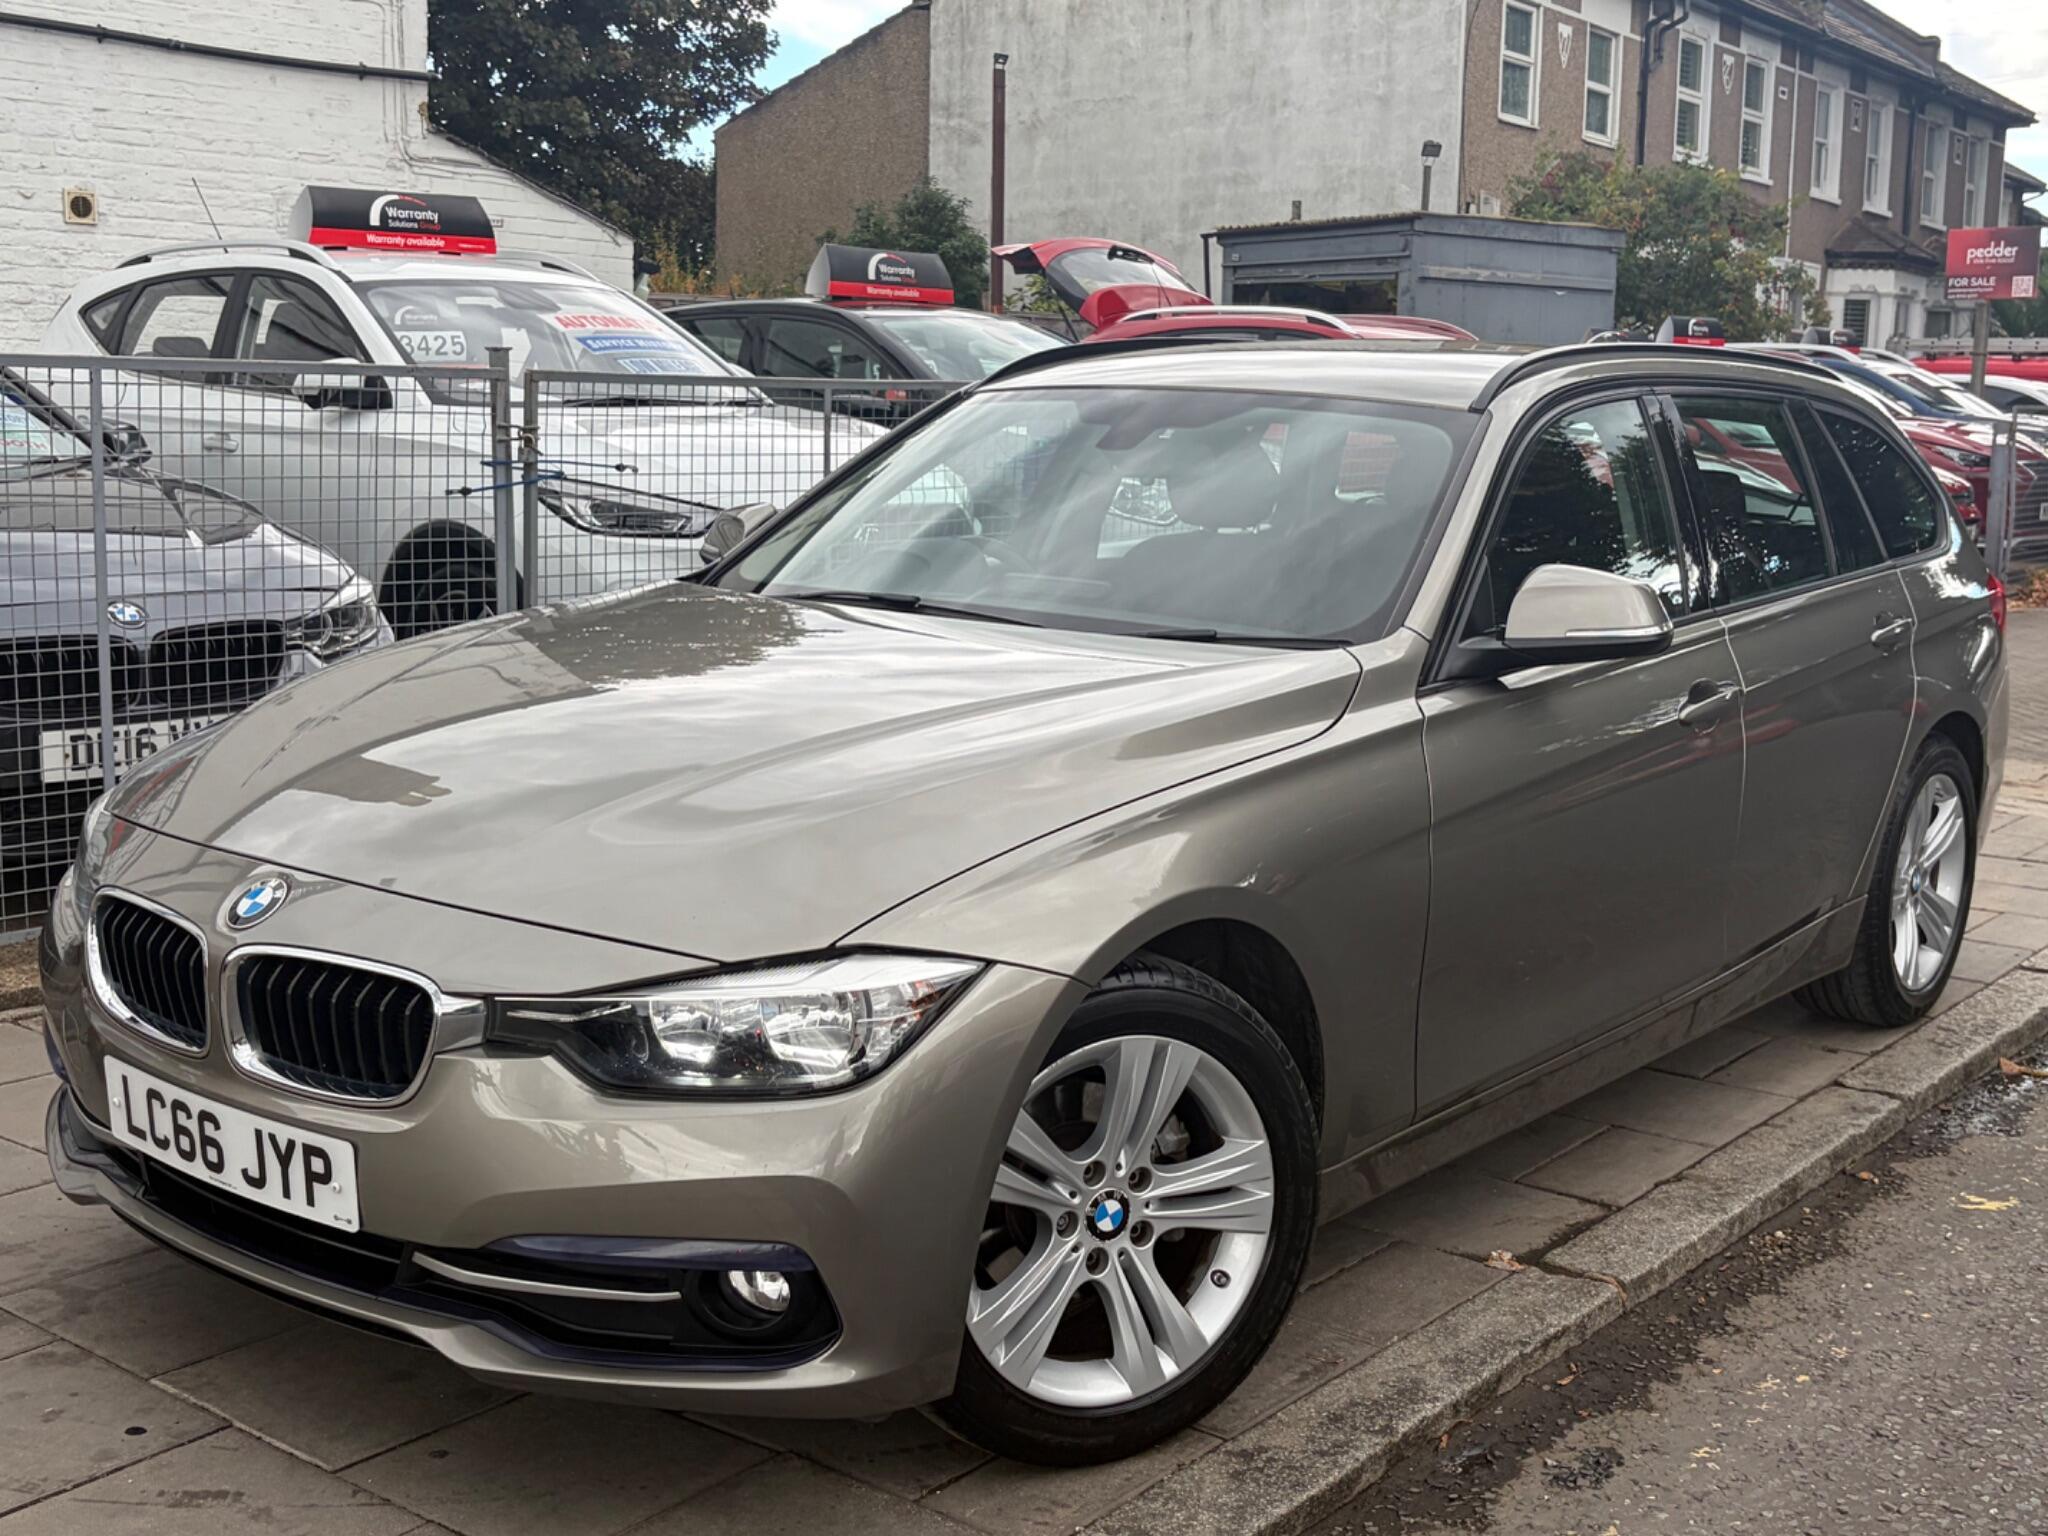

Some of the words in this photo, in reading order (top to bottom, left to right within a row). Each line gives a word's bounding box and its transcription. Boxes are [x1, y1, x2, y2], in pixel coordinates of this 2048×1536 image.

[385, 206, 439, 223] Warranty
[388, 220, 418, 229] Solutions
[366, 234, 405, 246] Warranty
[406, 237, 446, 247] available
[1966, 240, 2018, 264] pedder
[1948, 277, 1969, 287] FOR
[1970, 276, 1997, 287] SALE
[399, 335, 466, 357] 3425
[122, 1074, 225, 1175] LC66
[241, 1128, 332, 1208] JYP
